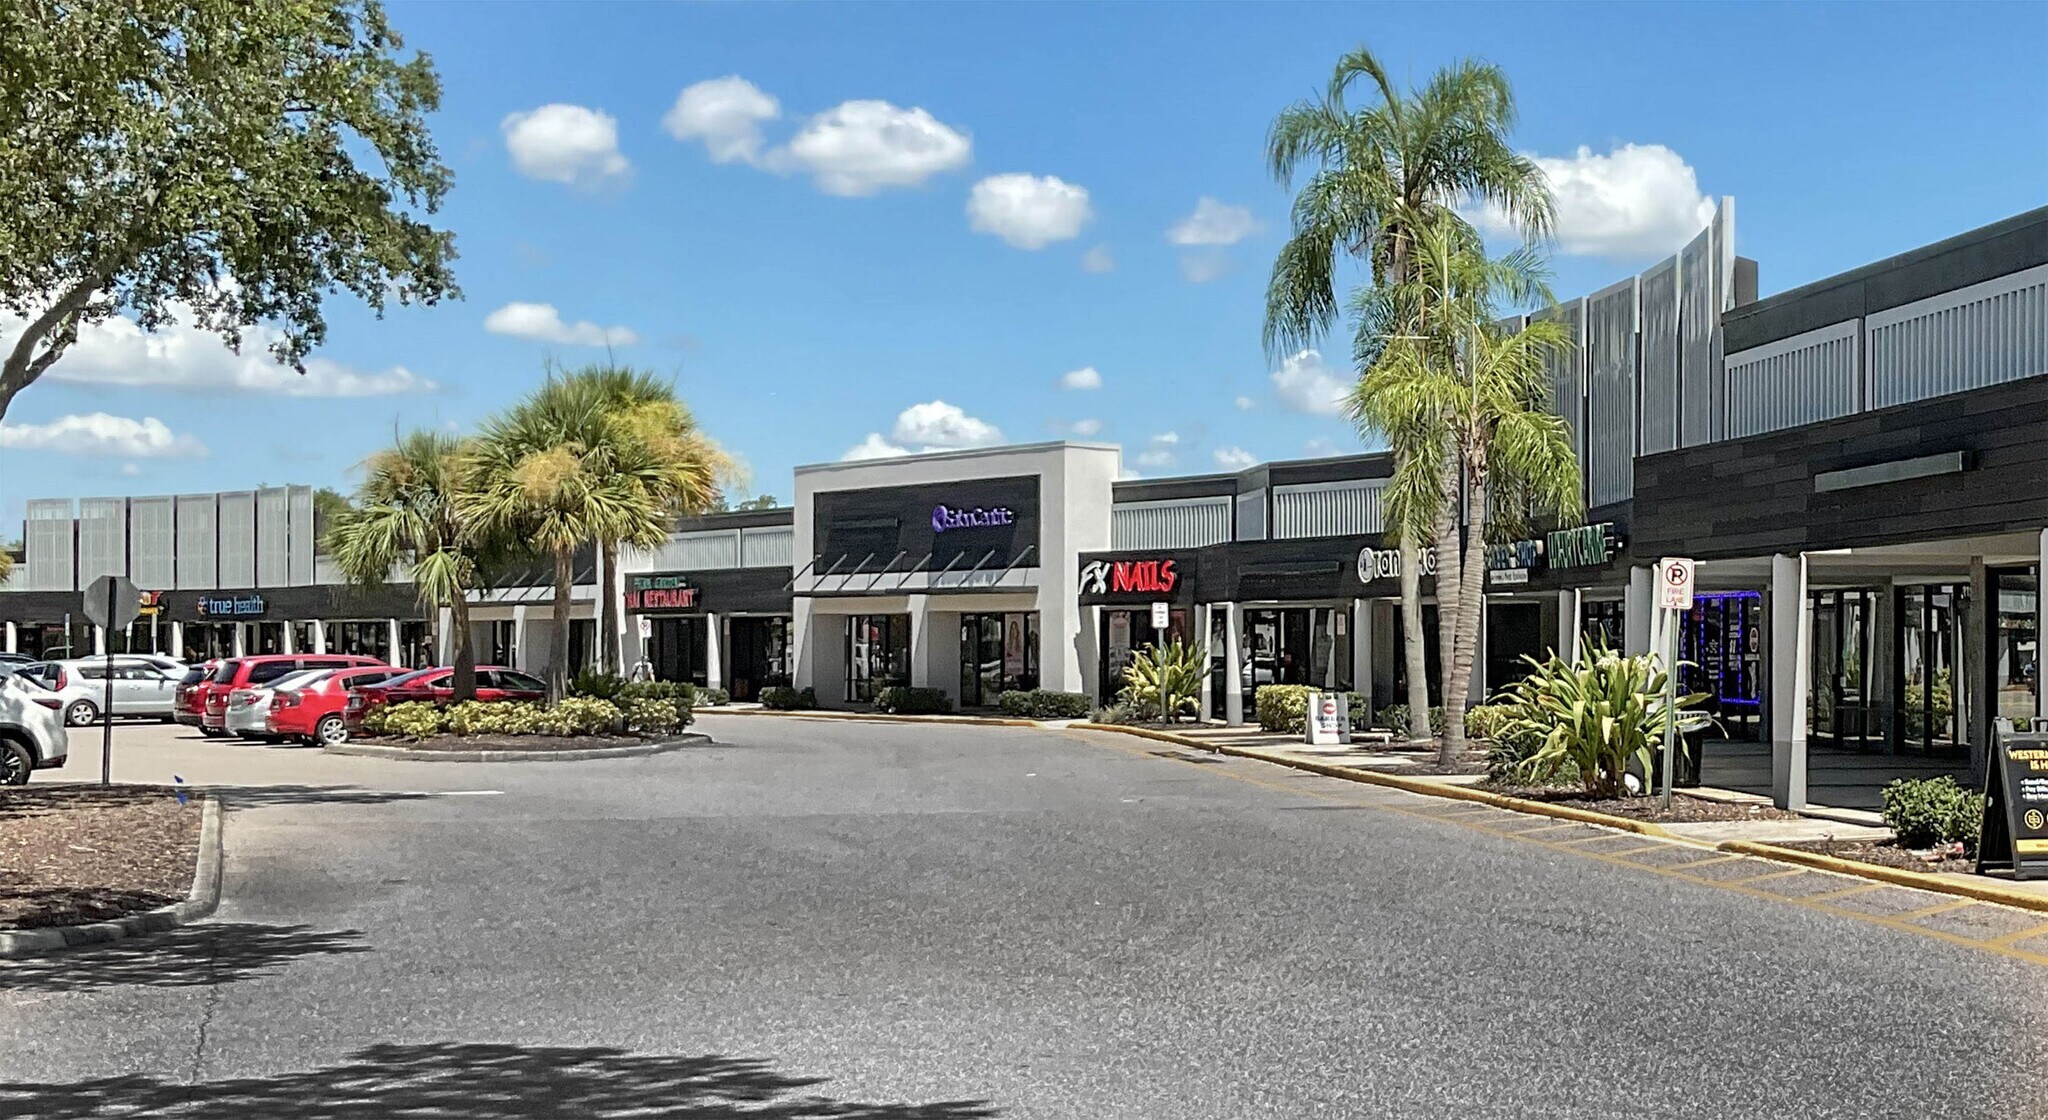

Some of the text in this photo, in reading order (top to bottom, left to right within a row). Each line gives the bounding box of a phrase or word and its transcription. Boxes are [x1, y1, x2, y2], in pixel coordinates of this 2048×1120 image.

[1078, 557, 1175, 595] FX NAILS
[209, 595, 264, 615] true health
[644, 588, 693, 608] RESTAURANT
[2030, 760, 2039, 770] IS
